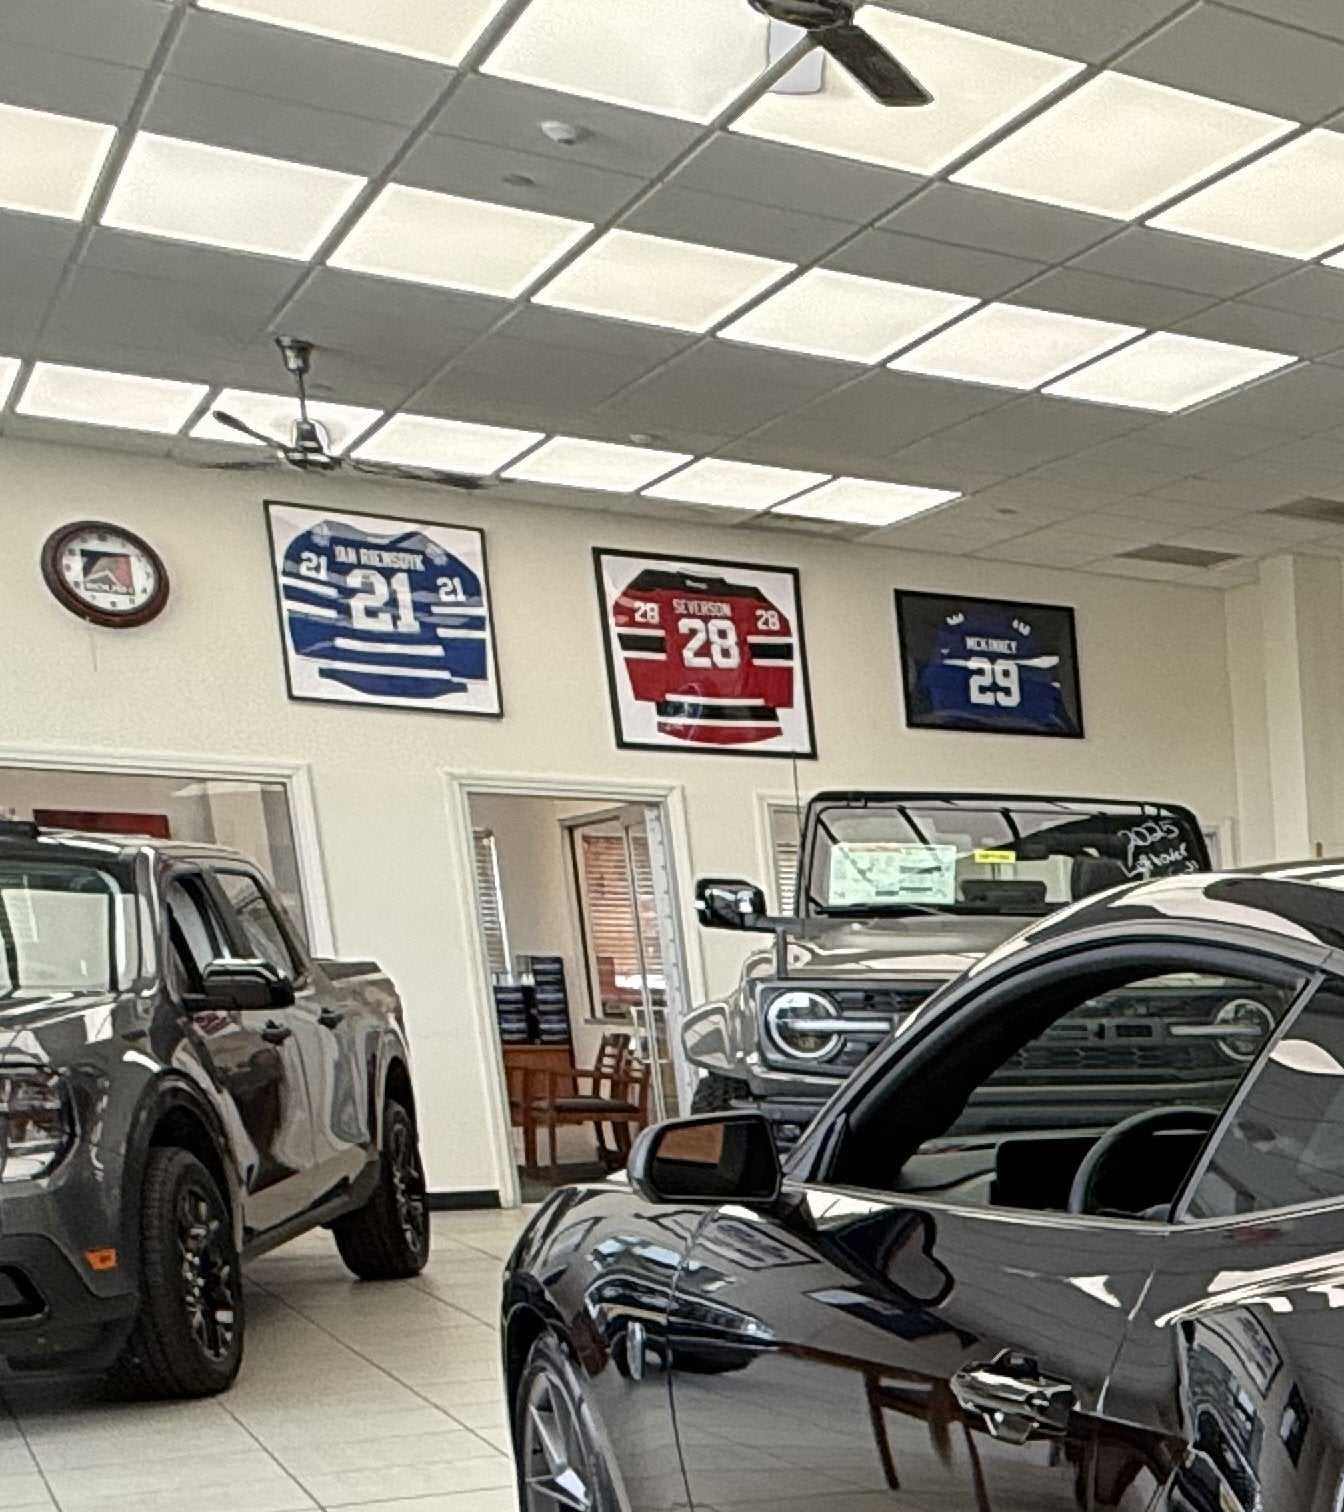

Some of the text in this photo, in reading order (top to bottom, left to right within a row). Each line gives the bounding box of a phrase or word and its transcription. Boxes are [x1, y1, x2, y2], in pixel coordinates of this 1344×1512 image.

[300, 551, 329, 581] 21
[346, 568, 421, 634] 21
[436, 577, 467, 602] 21
[633, 602, 661, 624] 28
[672, 598, 732, 618] SEVERSON
[755, 609, 781, 631] 28
[678, 617, 741, 670] 28
[968, 656, 1021, 708] 29
